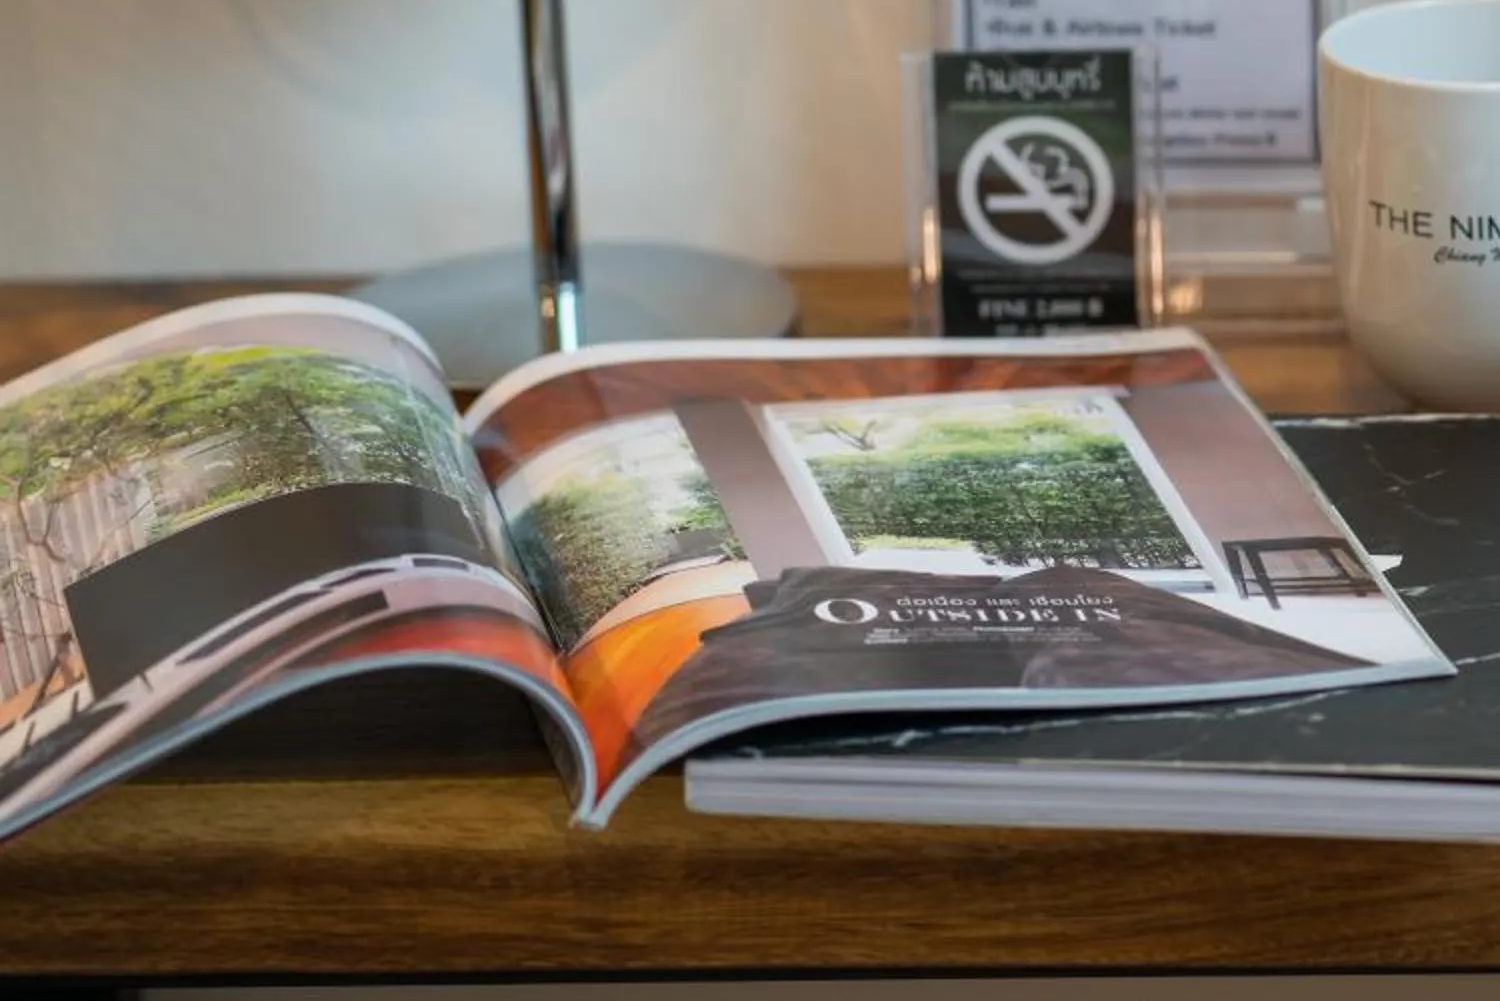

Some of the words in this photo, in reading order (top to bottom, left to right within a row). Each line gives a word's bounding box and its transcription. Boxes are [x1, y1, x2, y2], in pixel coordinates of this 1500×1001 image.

[1368, 200, 1435, 239] THE
[1433, 246, 1486, 267] Chiang
[1074, 607, 1123, 623] IN
